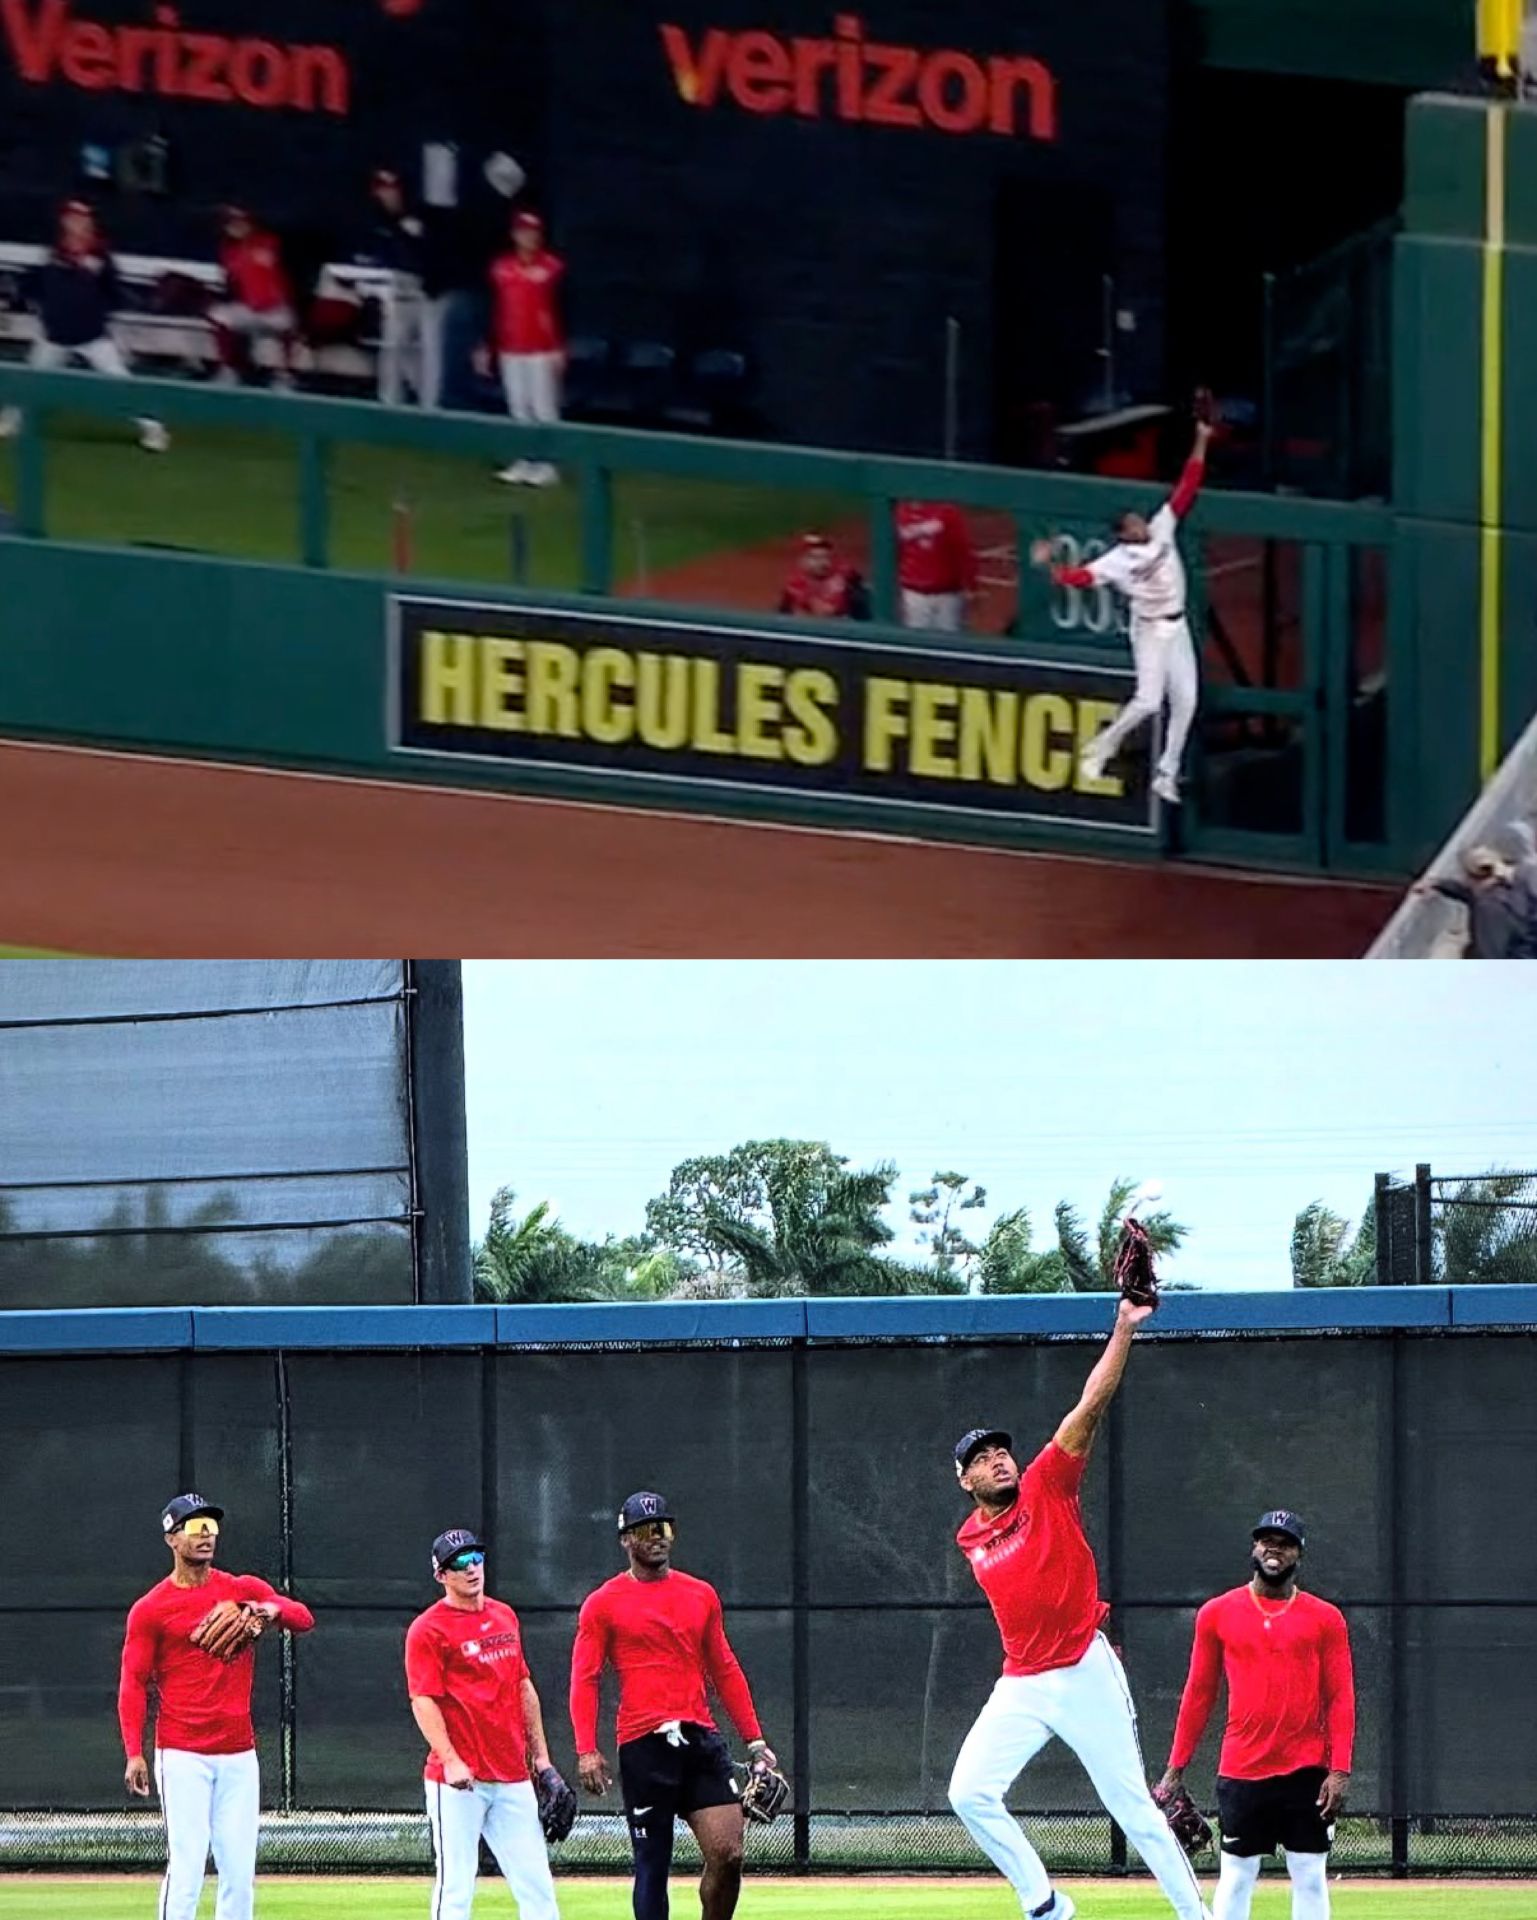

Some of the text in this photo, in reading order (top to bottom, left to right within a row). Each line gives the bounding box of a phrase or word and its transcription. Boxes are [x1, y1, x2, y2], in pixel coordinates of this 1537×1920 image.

[660, 14, 1056, 139] verizon
[421, 631, 1126, 796] HERCULES FENCE
[445, 1531, 465, 1548] W
[640, 1498, 657, 1515] W
